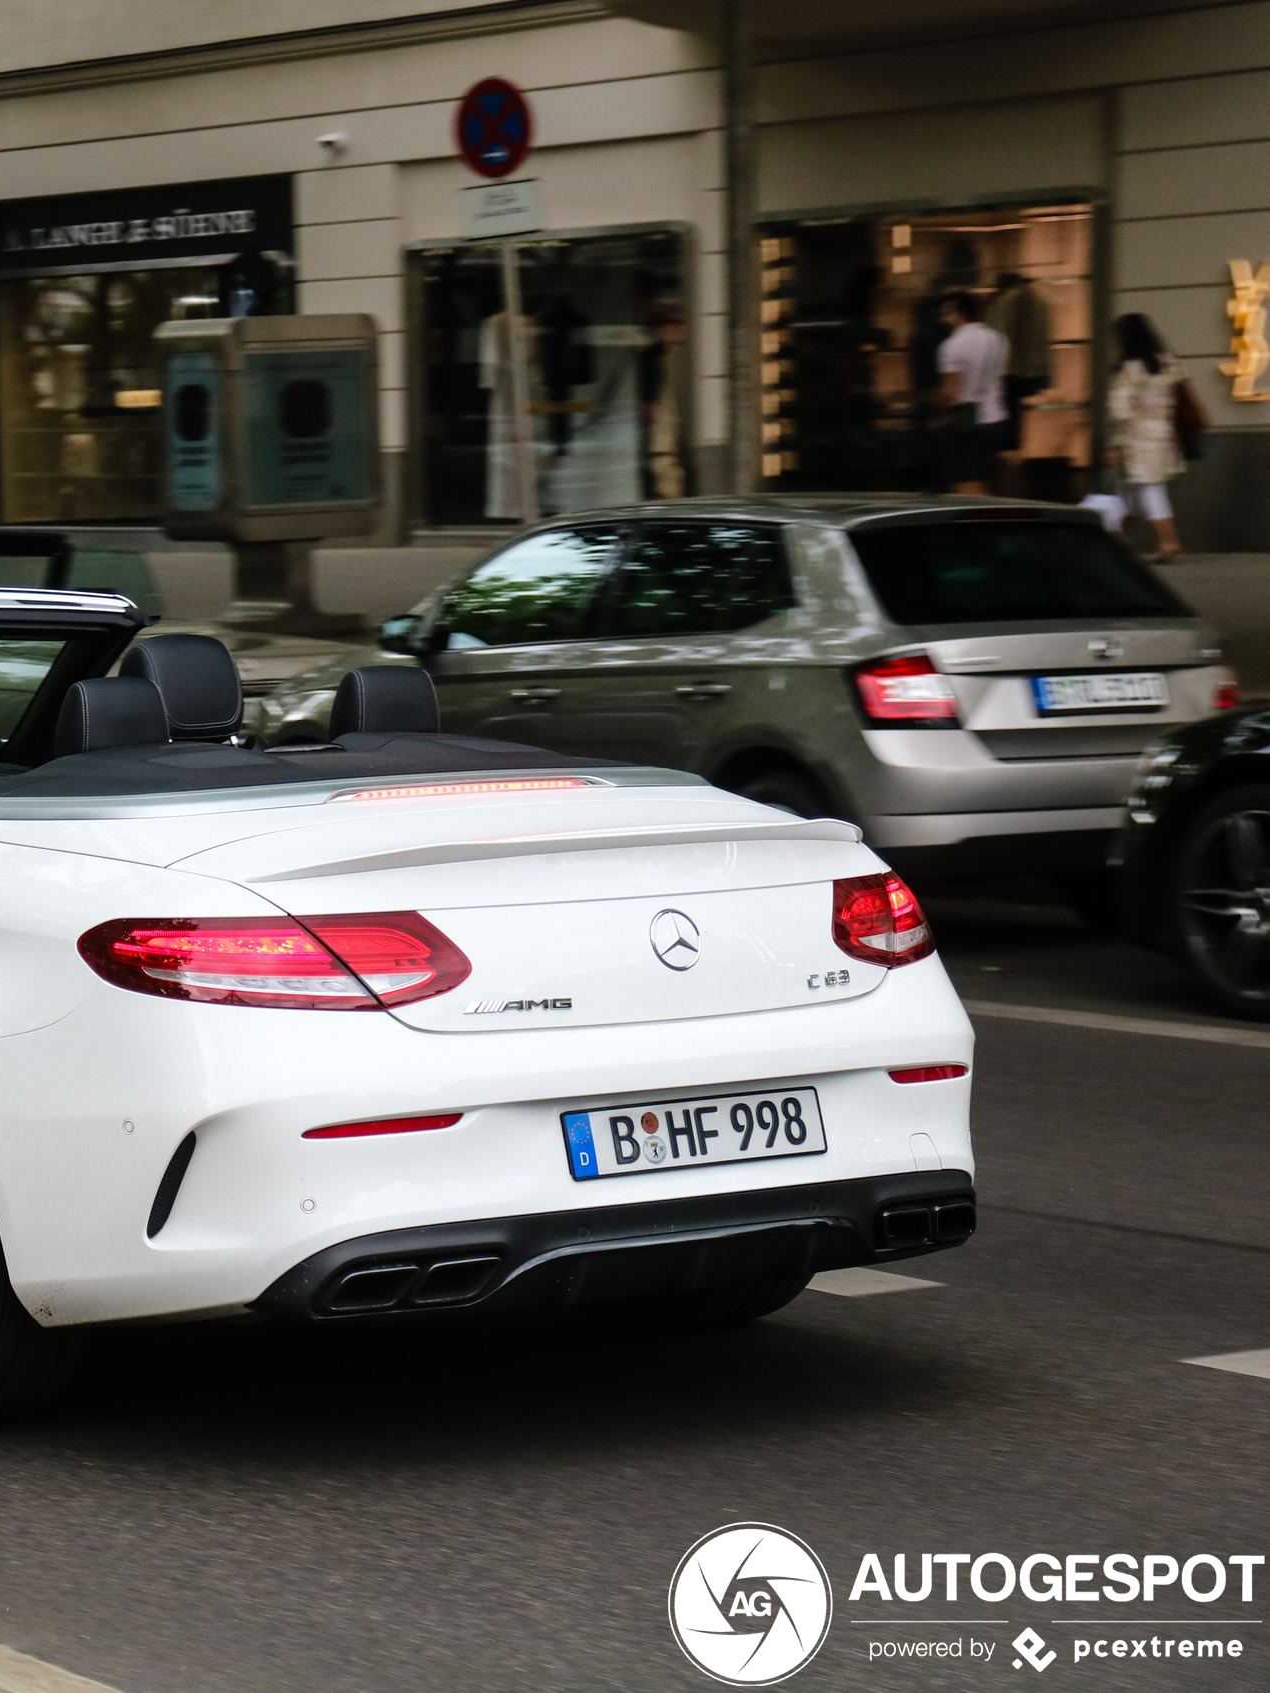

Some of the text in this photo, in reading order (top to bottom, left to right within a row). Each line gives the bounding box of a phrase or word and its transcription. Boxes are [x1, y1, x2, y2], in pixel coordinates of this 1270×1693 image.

[807, 969, 851, 991] C 63
[502, 997, 572, 1013] AMG
[609, 1096, 807, 1165] B HF 998
[580, 1152, 590, 1167] D
